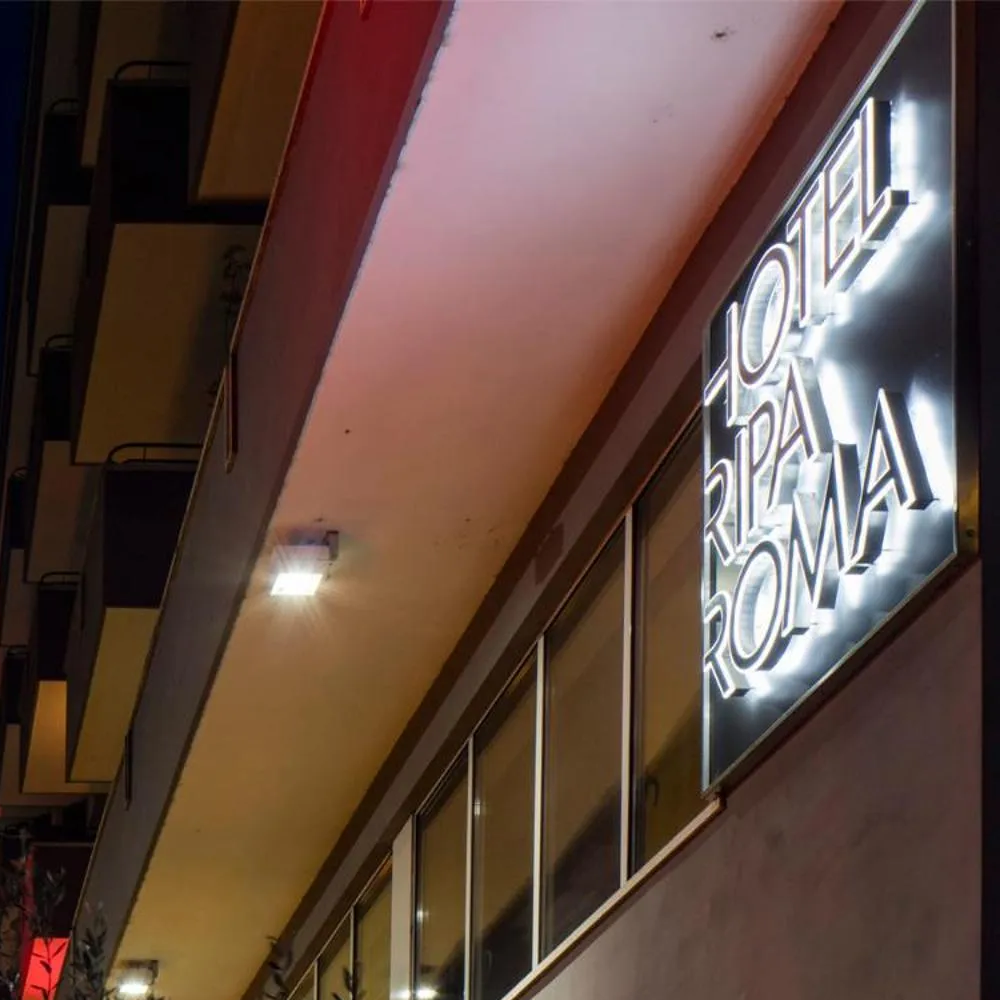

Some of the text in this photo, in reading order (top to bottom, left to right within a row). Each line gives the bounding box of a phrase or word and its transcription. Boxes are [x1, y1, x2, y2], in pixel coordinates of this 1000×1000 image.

[703, 96, 894, 427] HOTEL
[703, 354, 821, 567] RIPA
[703, 387, 919, 700] ROMA
